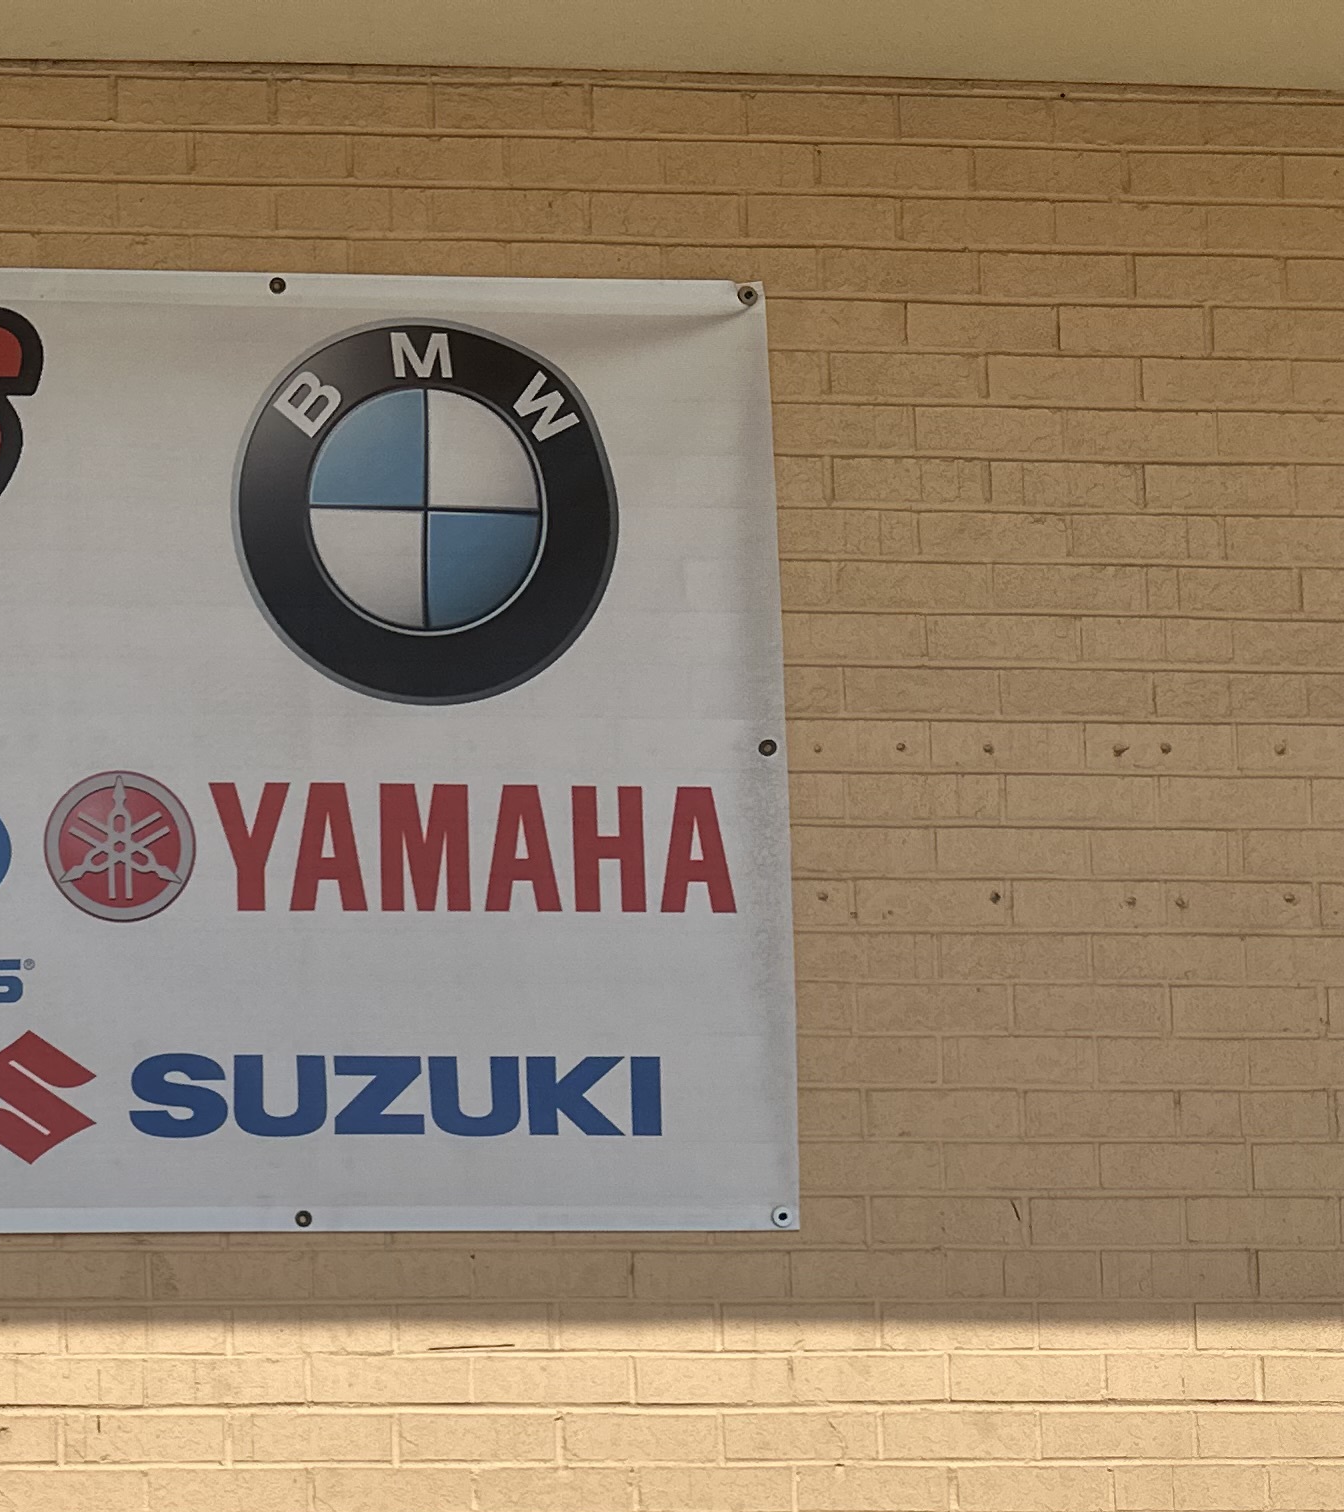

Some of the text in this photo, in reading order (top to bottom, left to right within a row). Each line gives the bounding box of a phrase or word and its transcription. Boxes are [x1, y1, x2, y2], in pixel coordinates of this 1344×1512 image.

[272, 331, 580, 443] BMW
[208, 781, 738, 914] YAMAHA
[128, 1052, 664, 1139] SUZUKI
